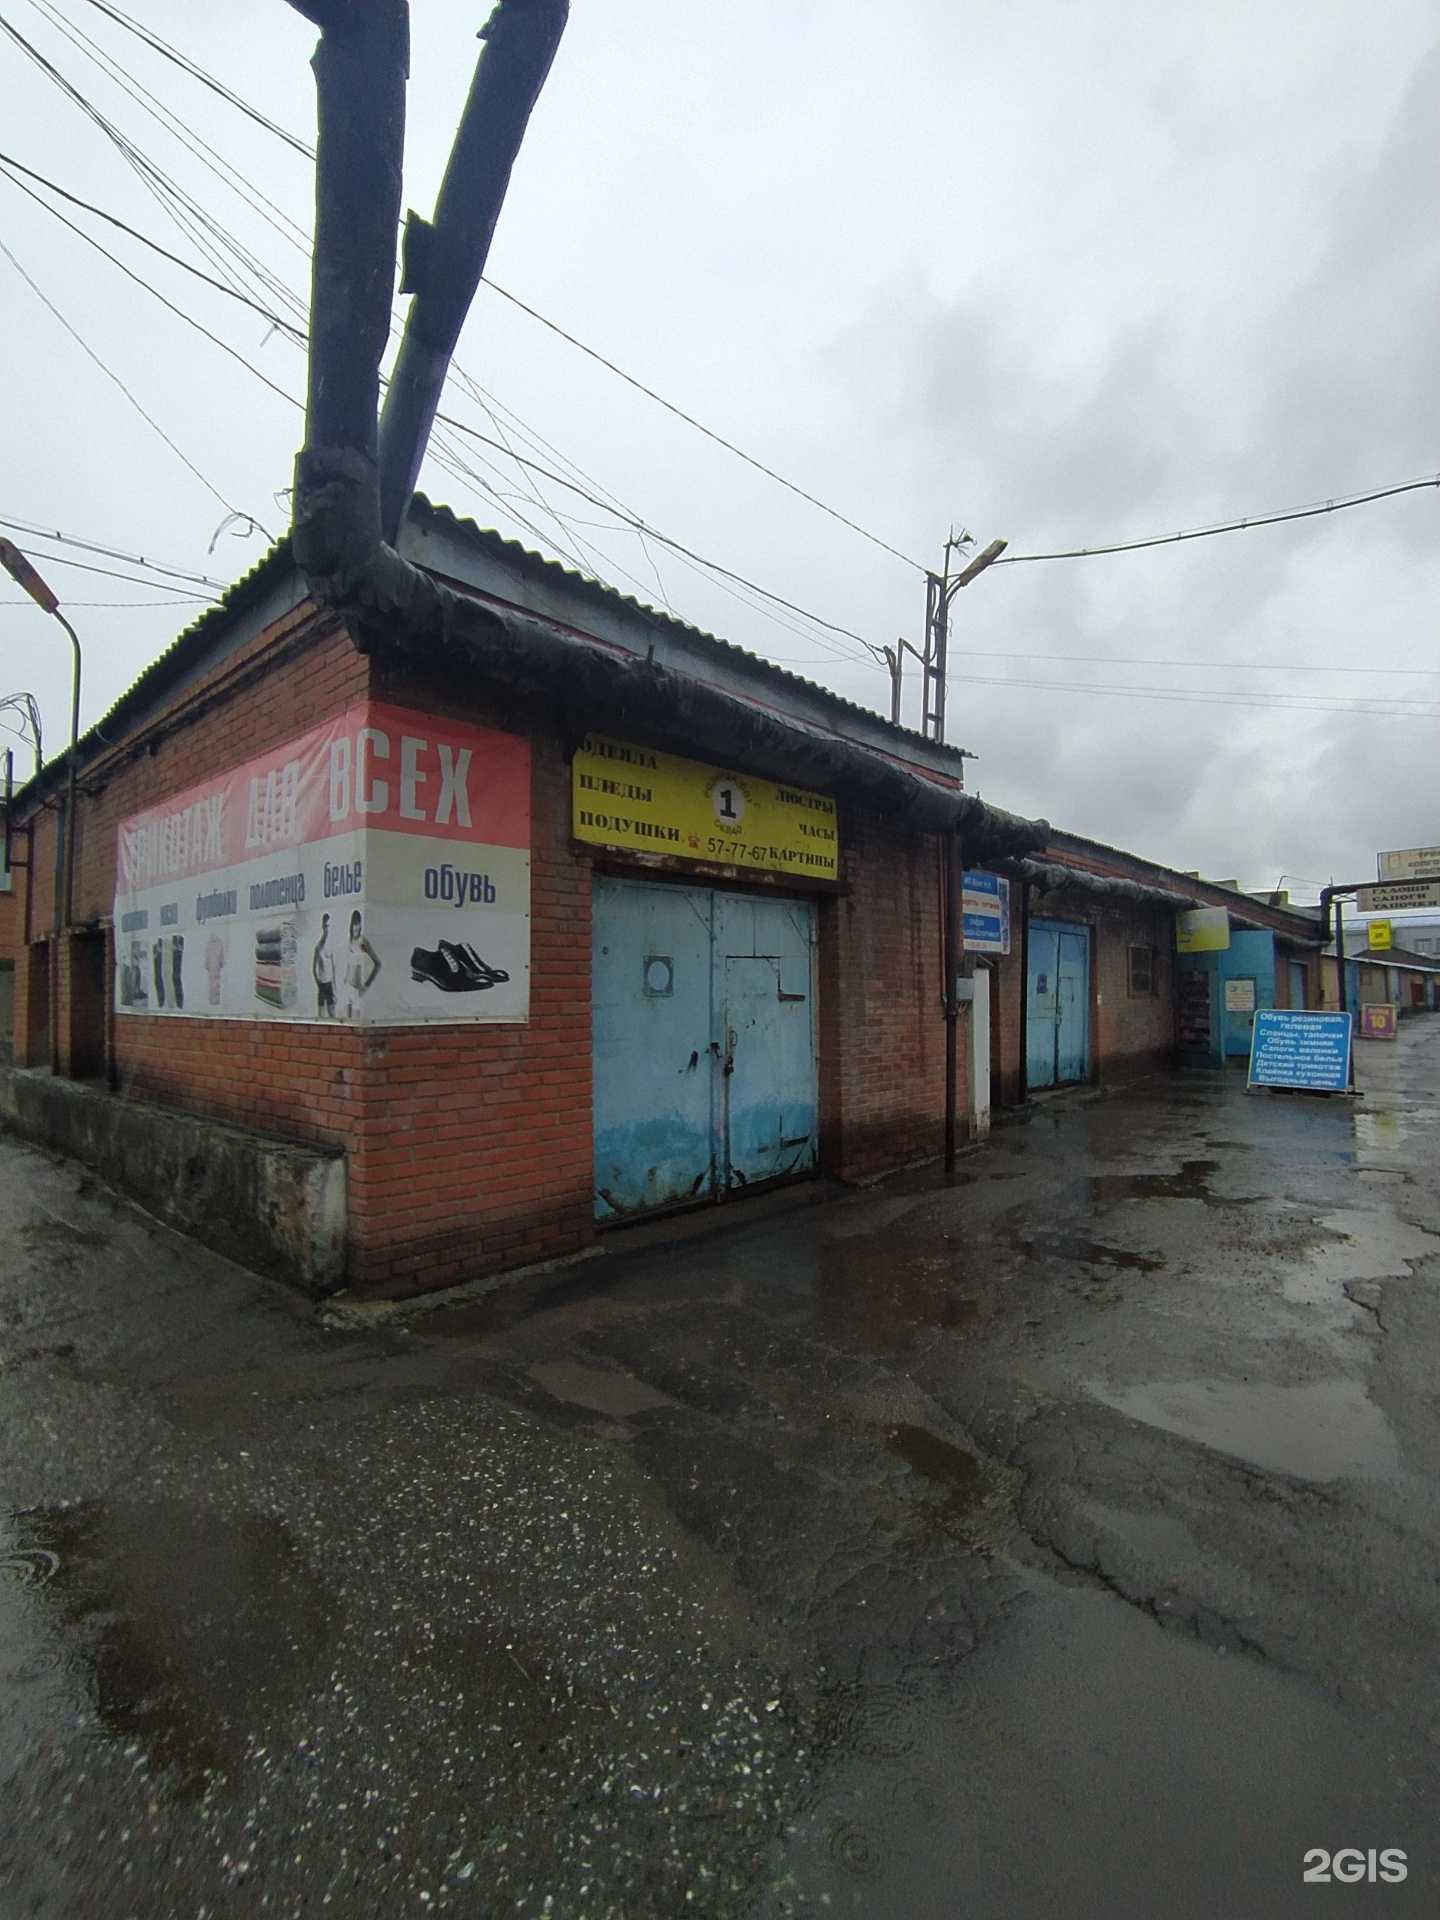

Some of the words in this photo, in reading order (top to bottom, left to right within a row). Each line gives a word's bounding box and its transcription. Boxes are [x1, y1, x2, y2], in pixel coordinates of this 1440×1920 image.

[245, 760, 300, 849] ДЛЯ
[330, 728, 473, 828] ВСЕХ
[580, 774, 652, 802] ПЛЕДЫ
[720, 790, 737, 819] 1
[776, 788, 834, 814] ЛЮСТРЫ
[580, 811, 680, 842] ПОДУШКИ
[800, 823, 835, 841] ЧАСЫ
[707, 838, 768, 860] 57-77-67
[768, 847, 835, 869] КАРТИНЫ
[323, 861, 362, 899] белье
[424, 864, 496, 908] обувь
[1372, 893, 1427, 902] САПОГИ
[1372, 901, 1438, 910] ТАПОЧКИ
[1260, 1013, 1290, 1022] Обувь
